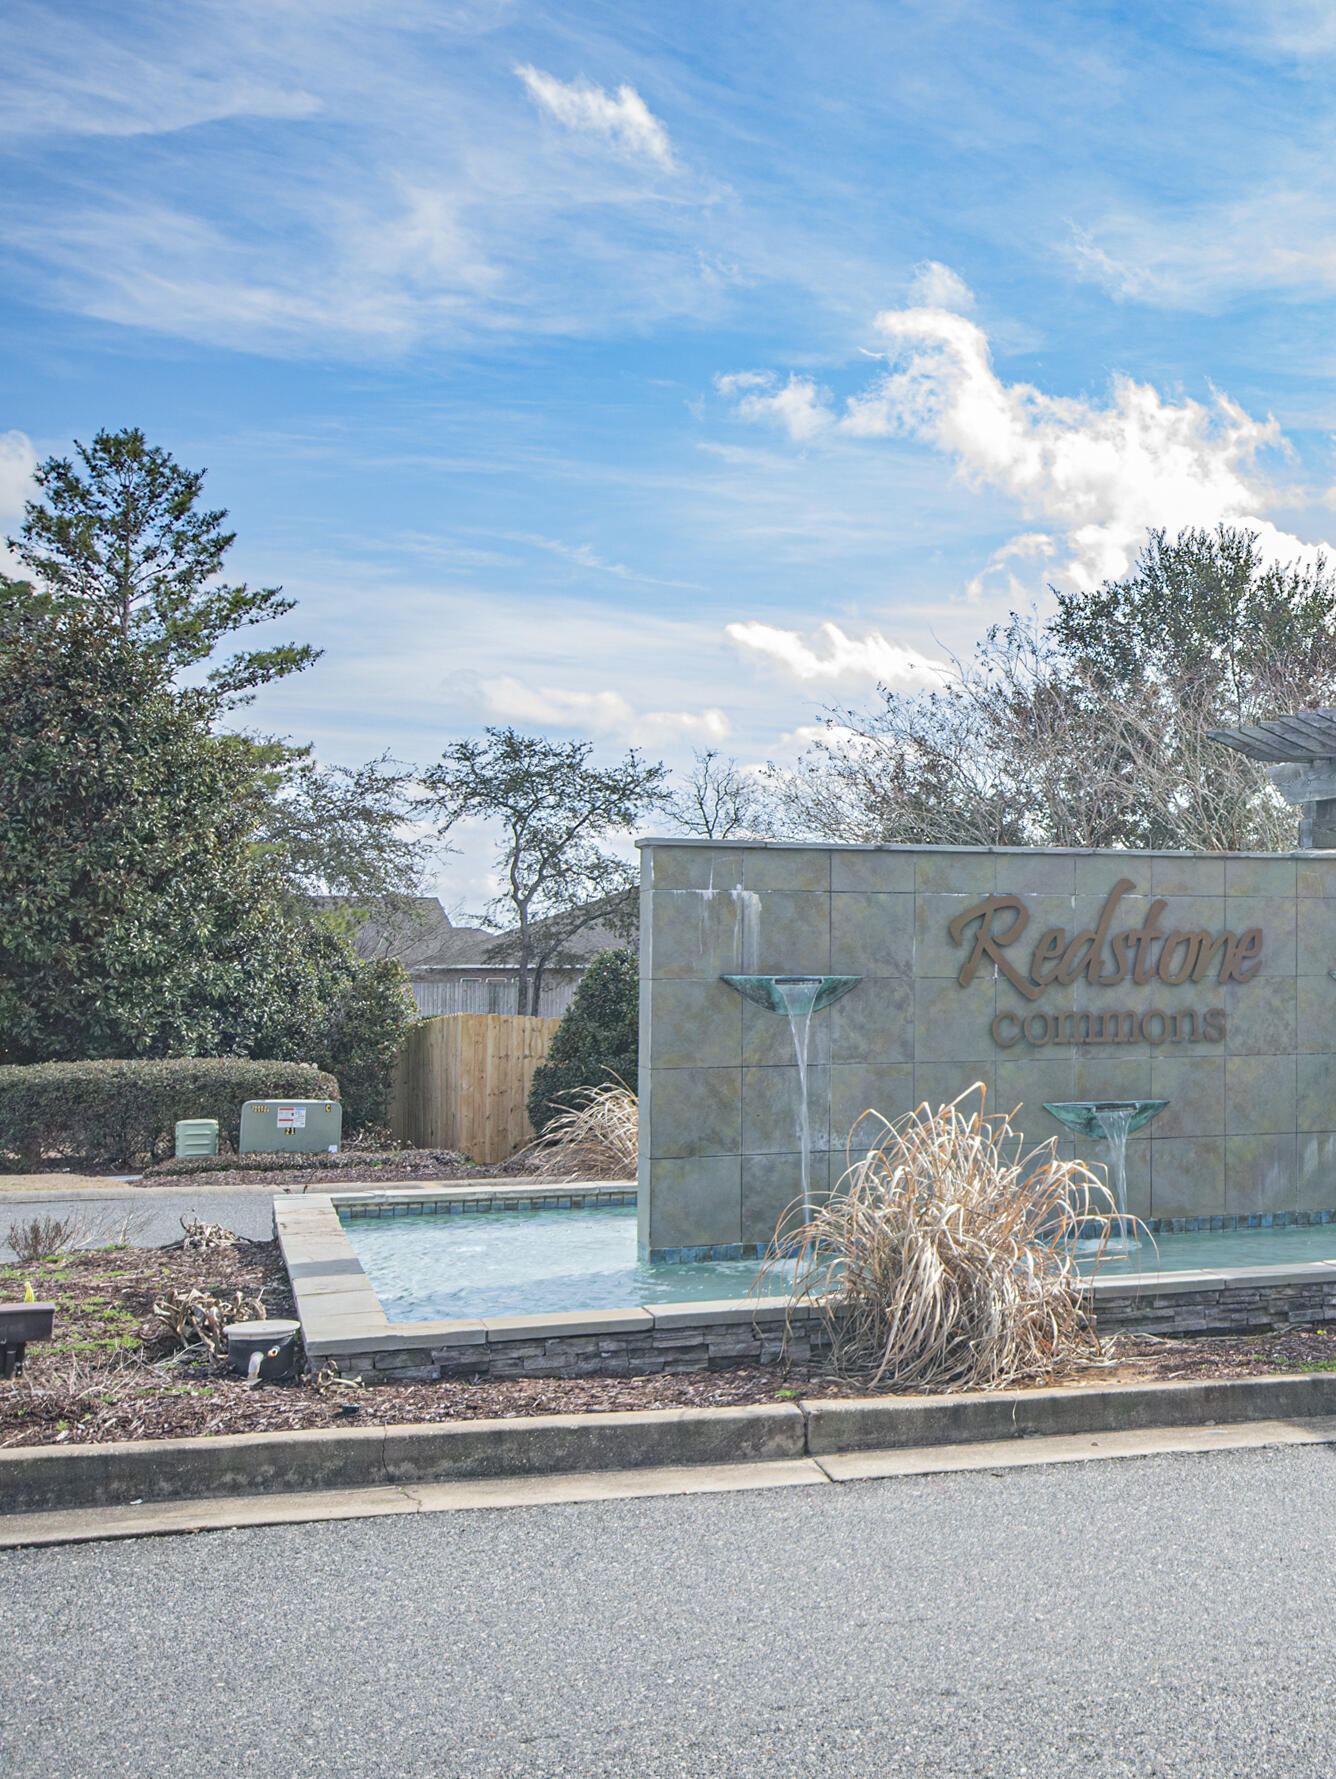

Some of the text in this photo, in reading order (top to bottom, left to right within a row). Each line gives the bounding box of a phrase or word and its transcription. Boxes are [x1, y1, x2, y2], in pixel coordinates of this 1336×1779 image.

[949, 878, 1263, 1000] Redstone
[991, 1007, 1227, 1047] commons
[325, 1104, 331, 1112] C
